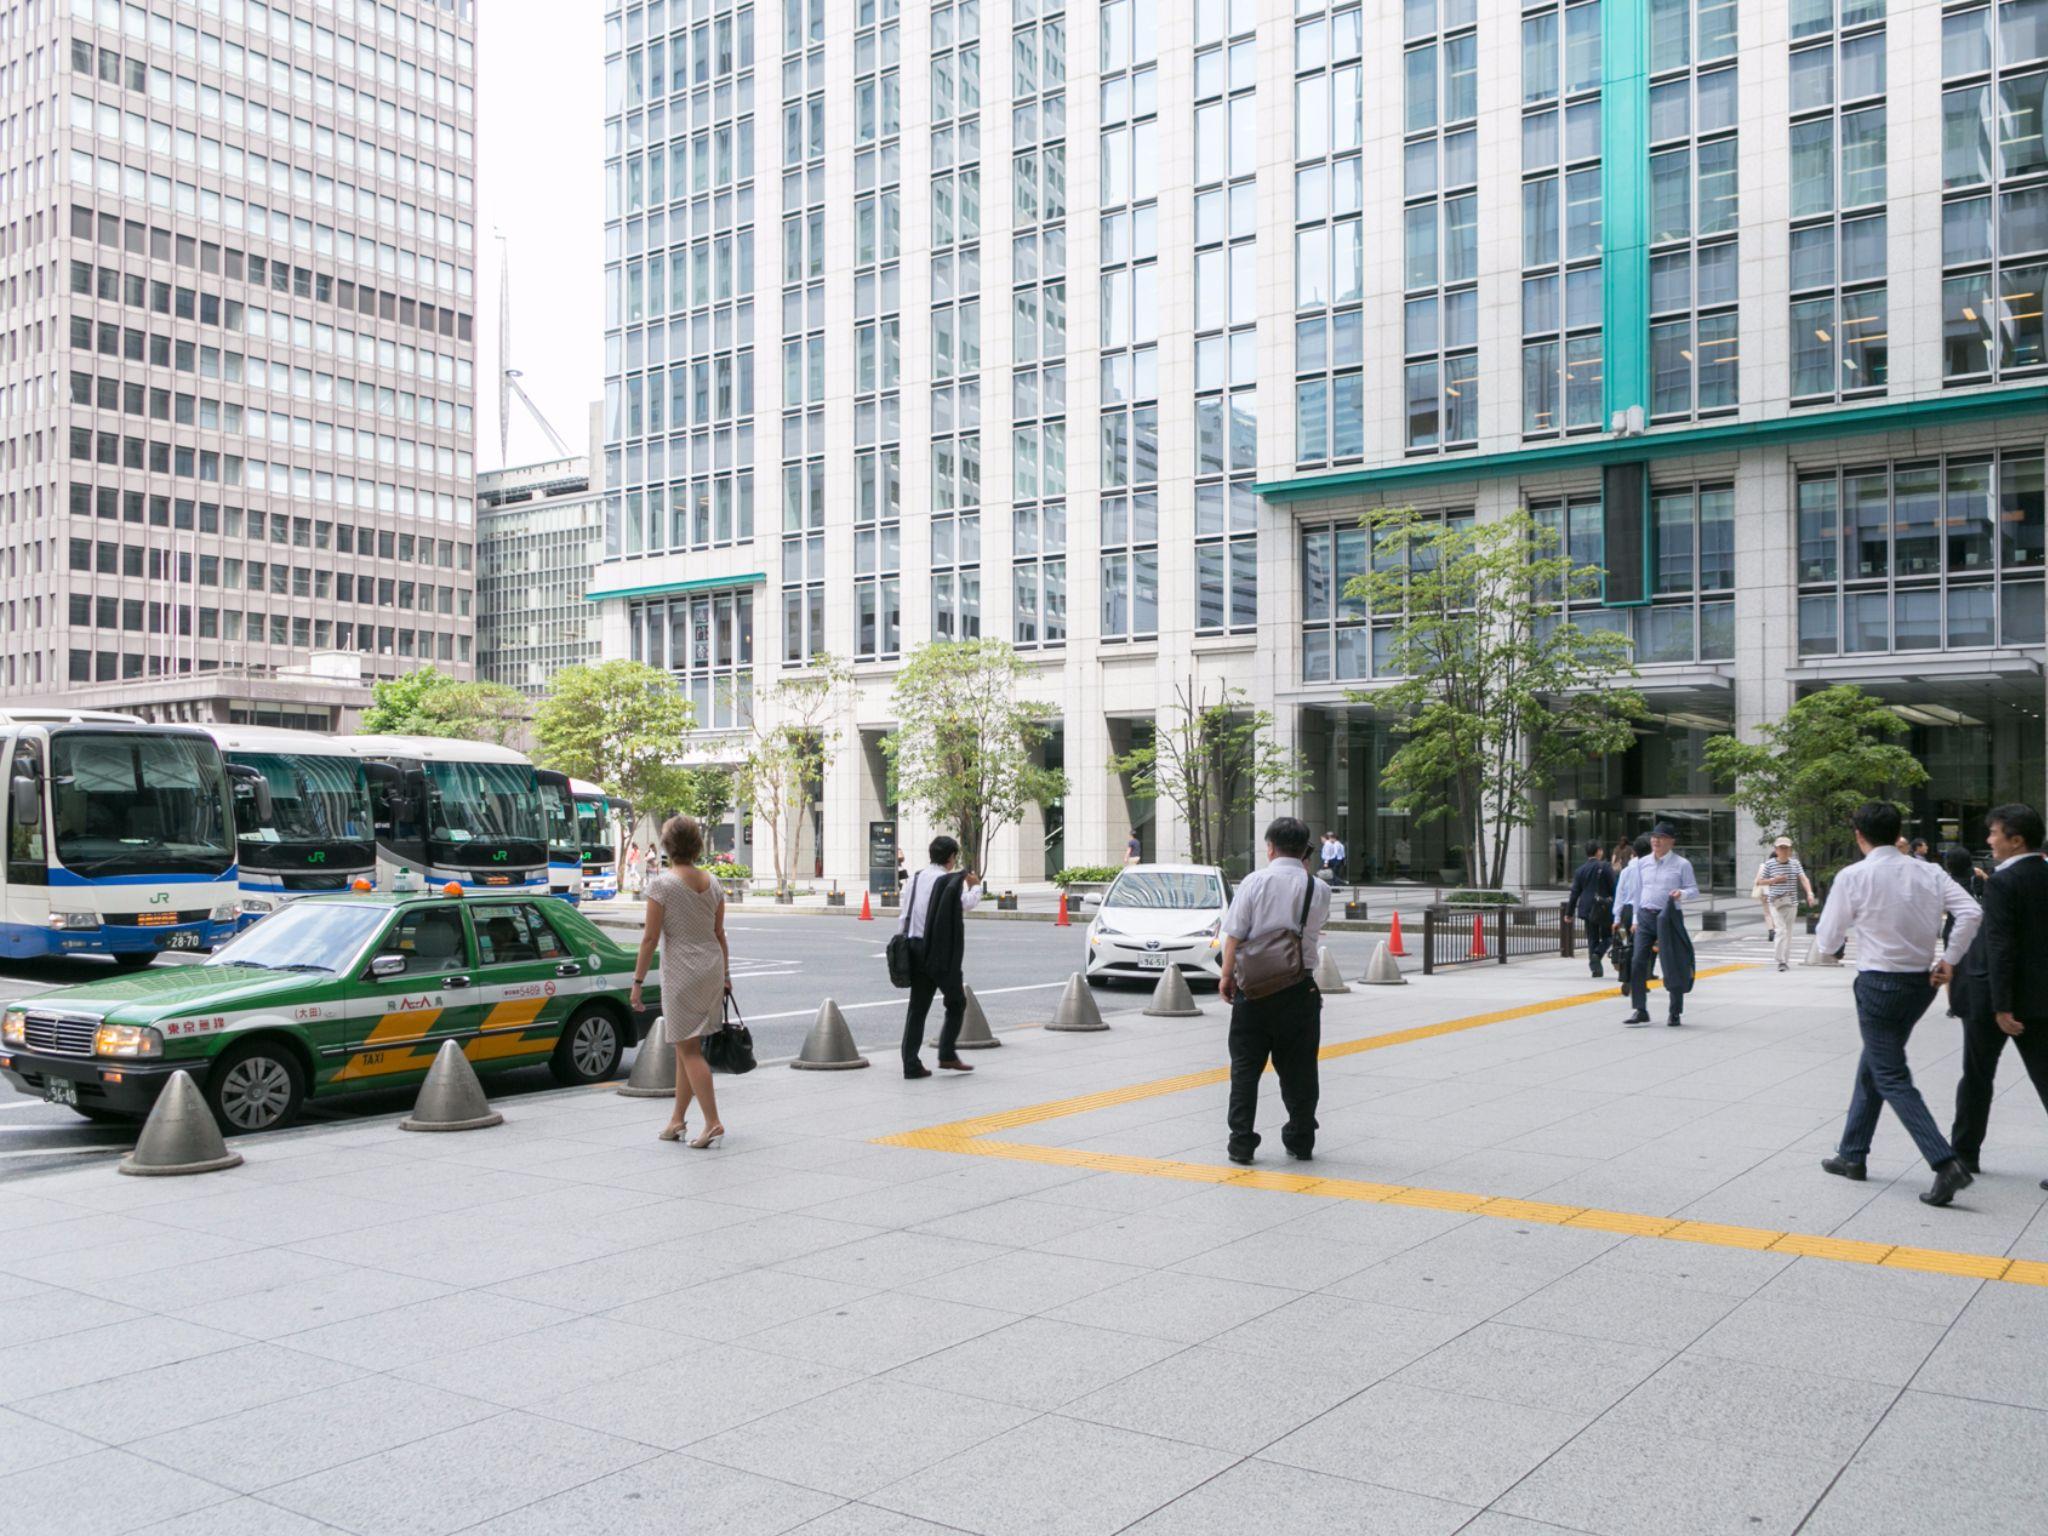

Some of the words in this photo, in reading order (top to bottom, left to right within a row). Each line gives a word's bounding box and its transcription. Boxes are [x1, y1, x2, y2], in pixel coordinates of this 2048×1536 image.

[308, 851, 326, 862] JR
[492, 850, 508, 861] JR
[149, 892, 170, 904] JR
[171, 935, 200, 948] 28-70
[362, 1051, 385, 1066] TAXI
